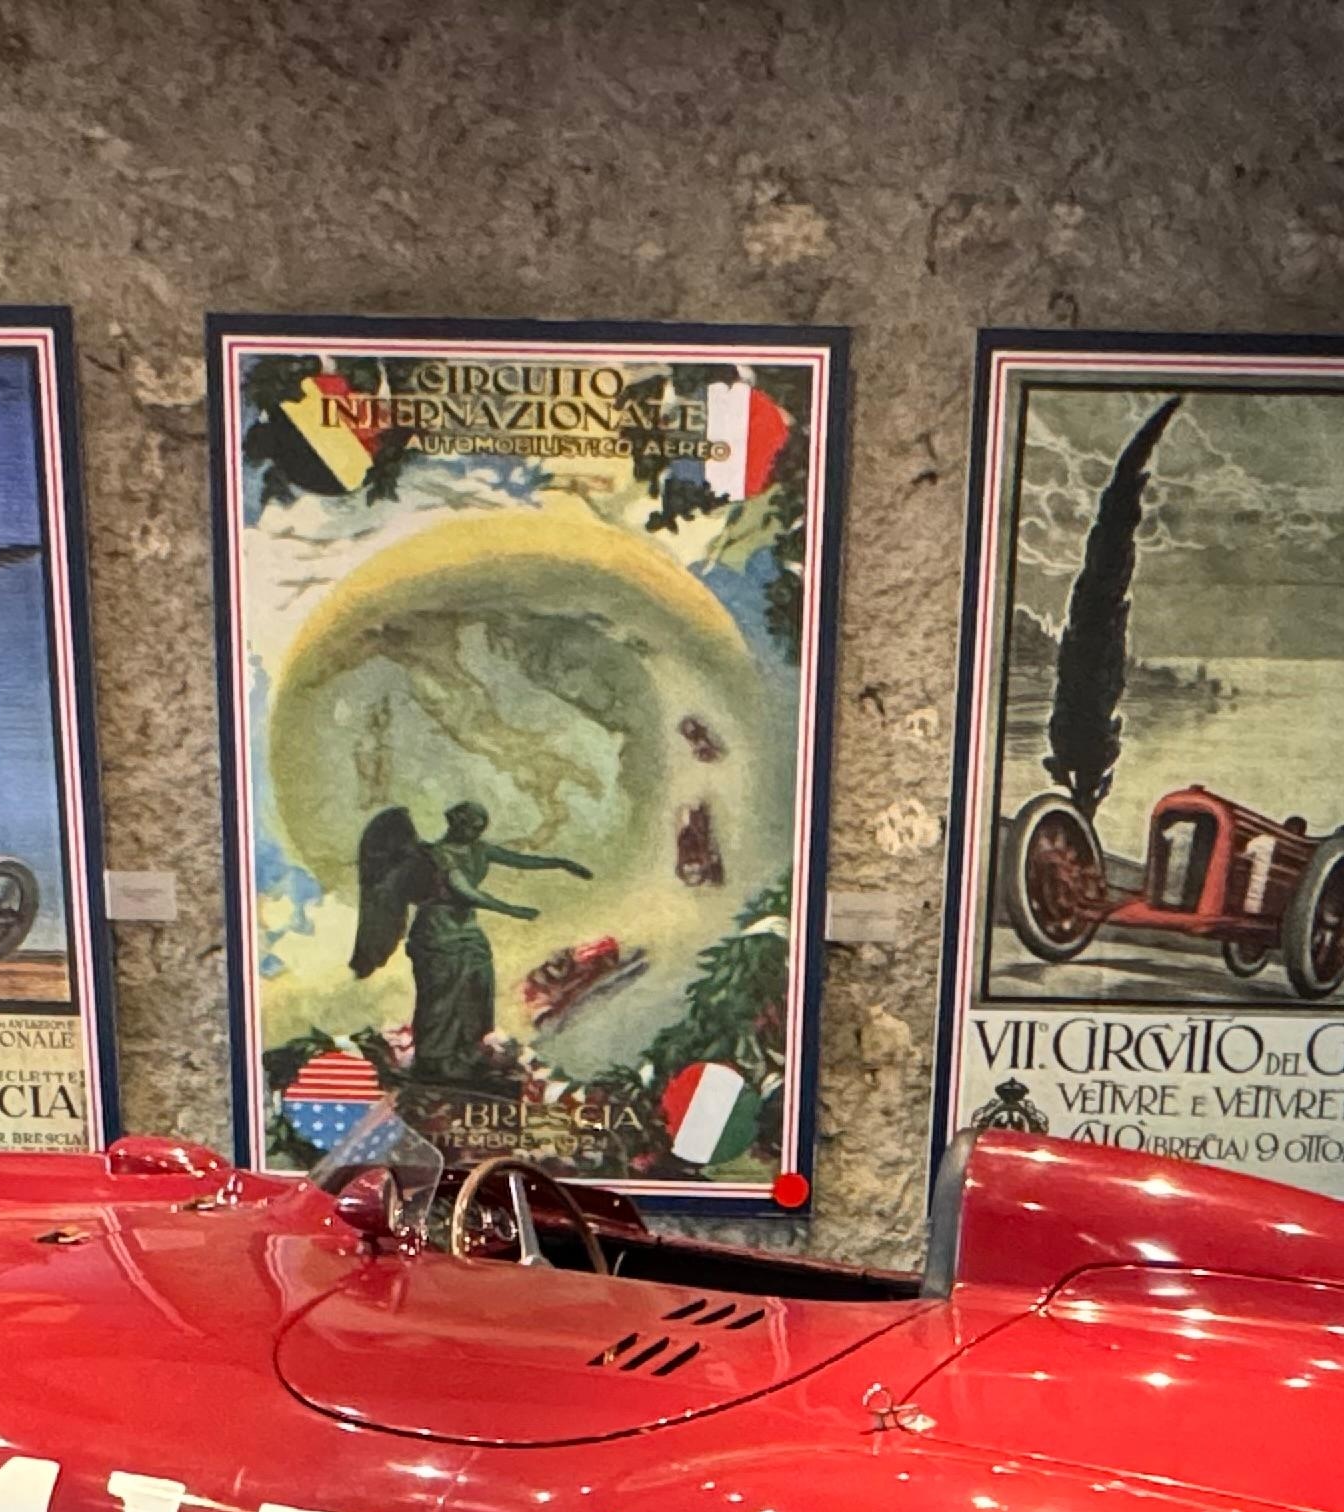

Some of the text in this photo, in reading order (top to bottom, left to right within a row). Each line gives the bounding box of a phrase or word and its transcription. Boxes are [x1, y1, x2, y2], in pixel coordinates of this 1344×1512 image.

[416, 365, 624, 399] CIRCUITO
[1264, 1052, 1308, 1076] DEL
[1255, 1132, 1279, 1162] 9
